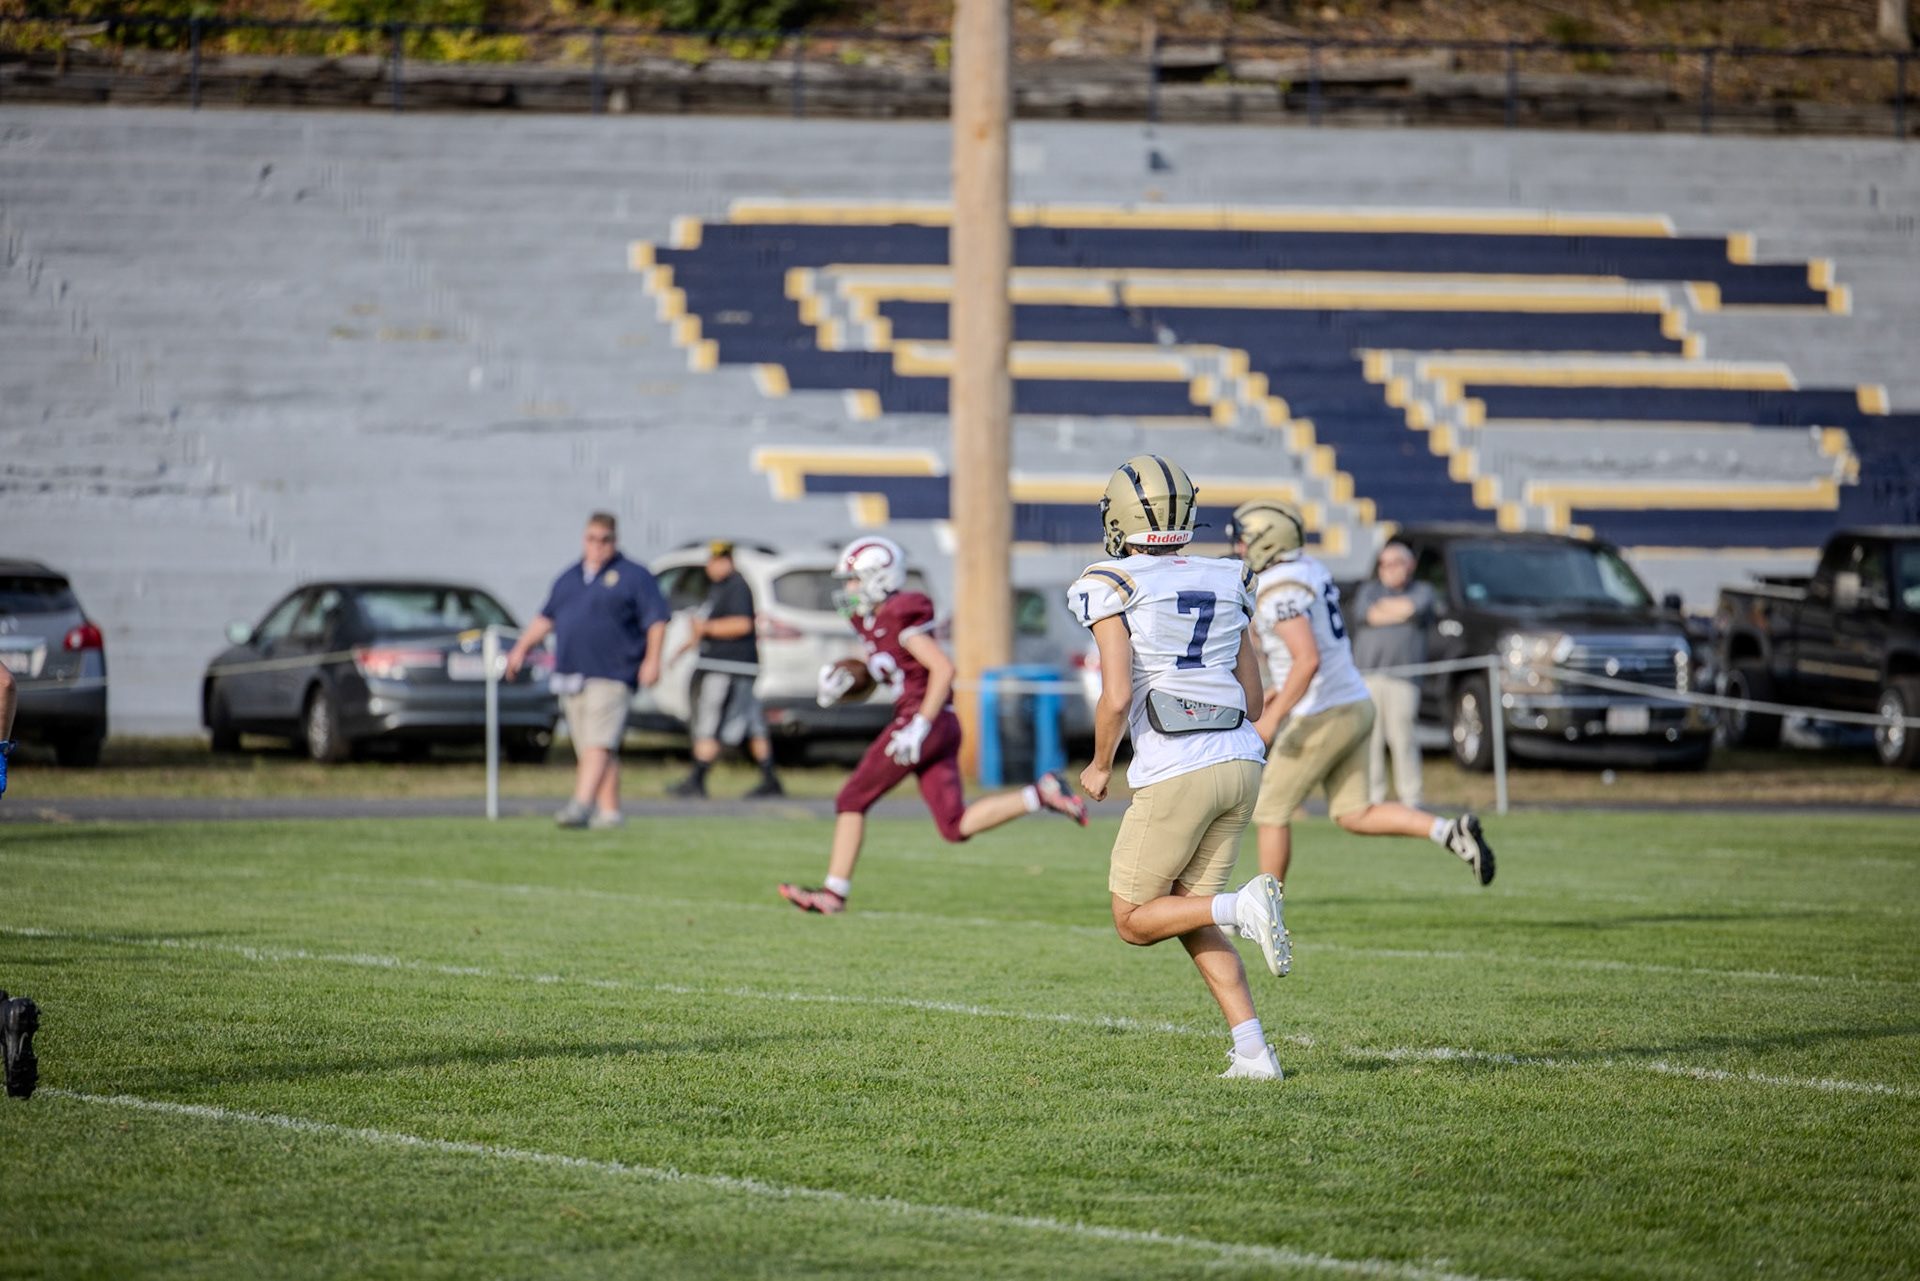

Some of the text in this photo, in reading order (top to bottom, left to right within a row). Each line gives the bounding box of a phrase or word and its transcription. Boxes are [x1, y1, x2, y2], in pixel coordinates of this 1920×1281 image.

[1146, 533, 1189, 543] Riddell
[1079, 592, 1090, 621] 7
[1275, 599, 1301, 621] 66
[1176, 590, 1217, 670] 7
